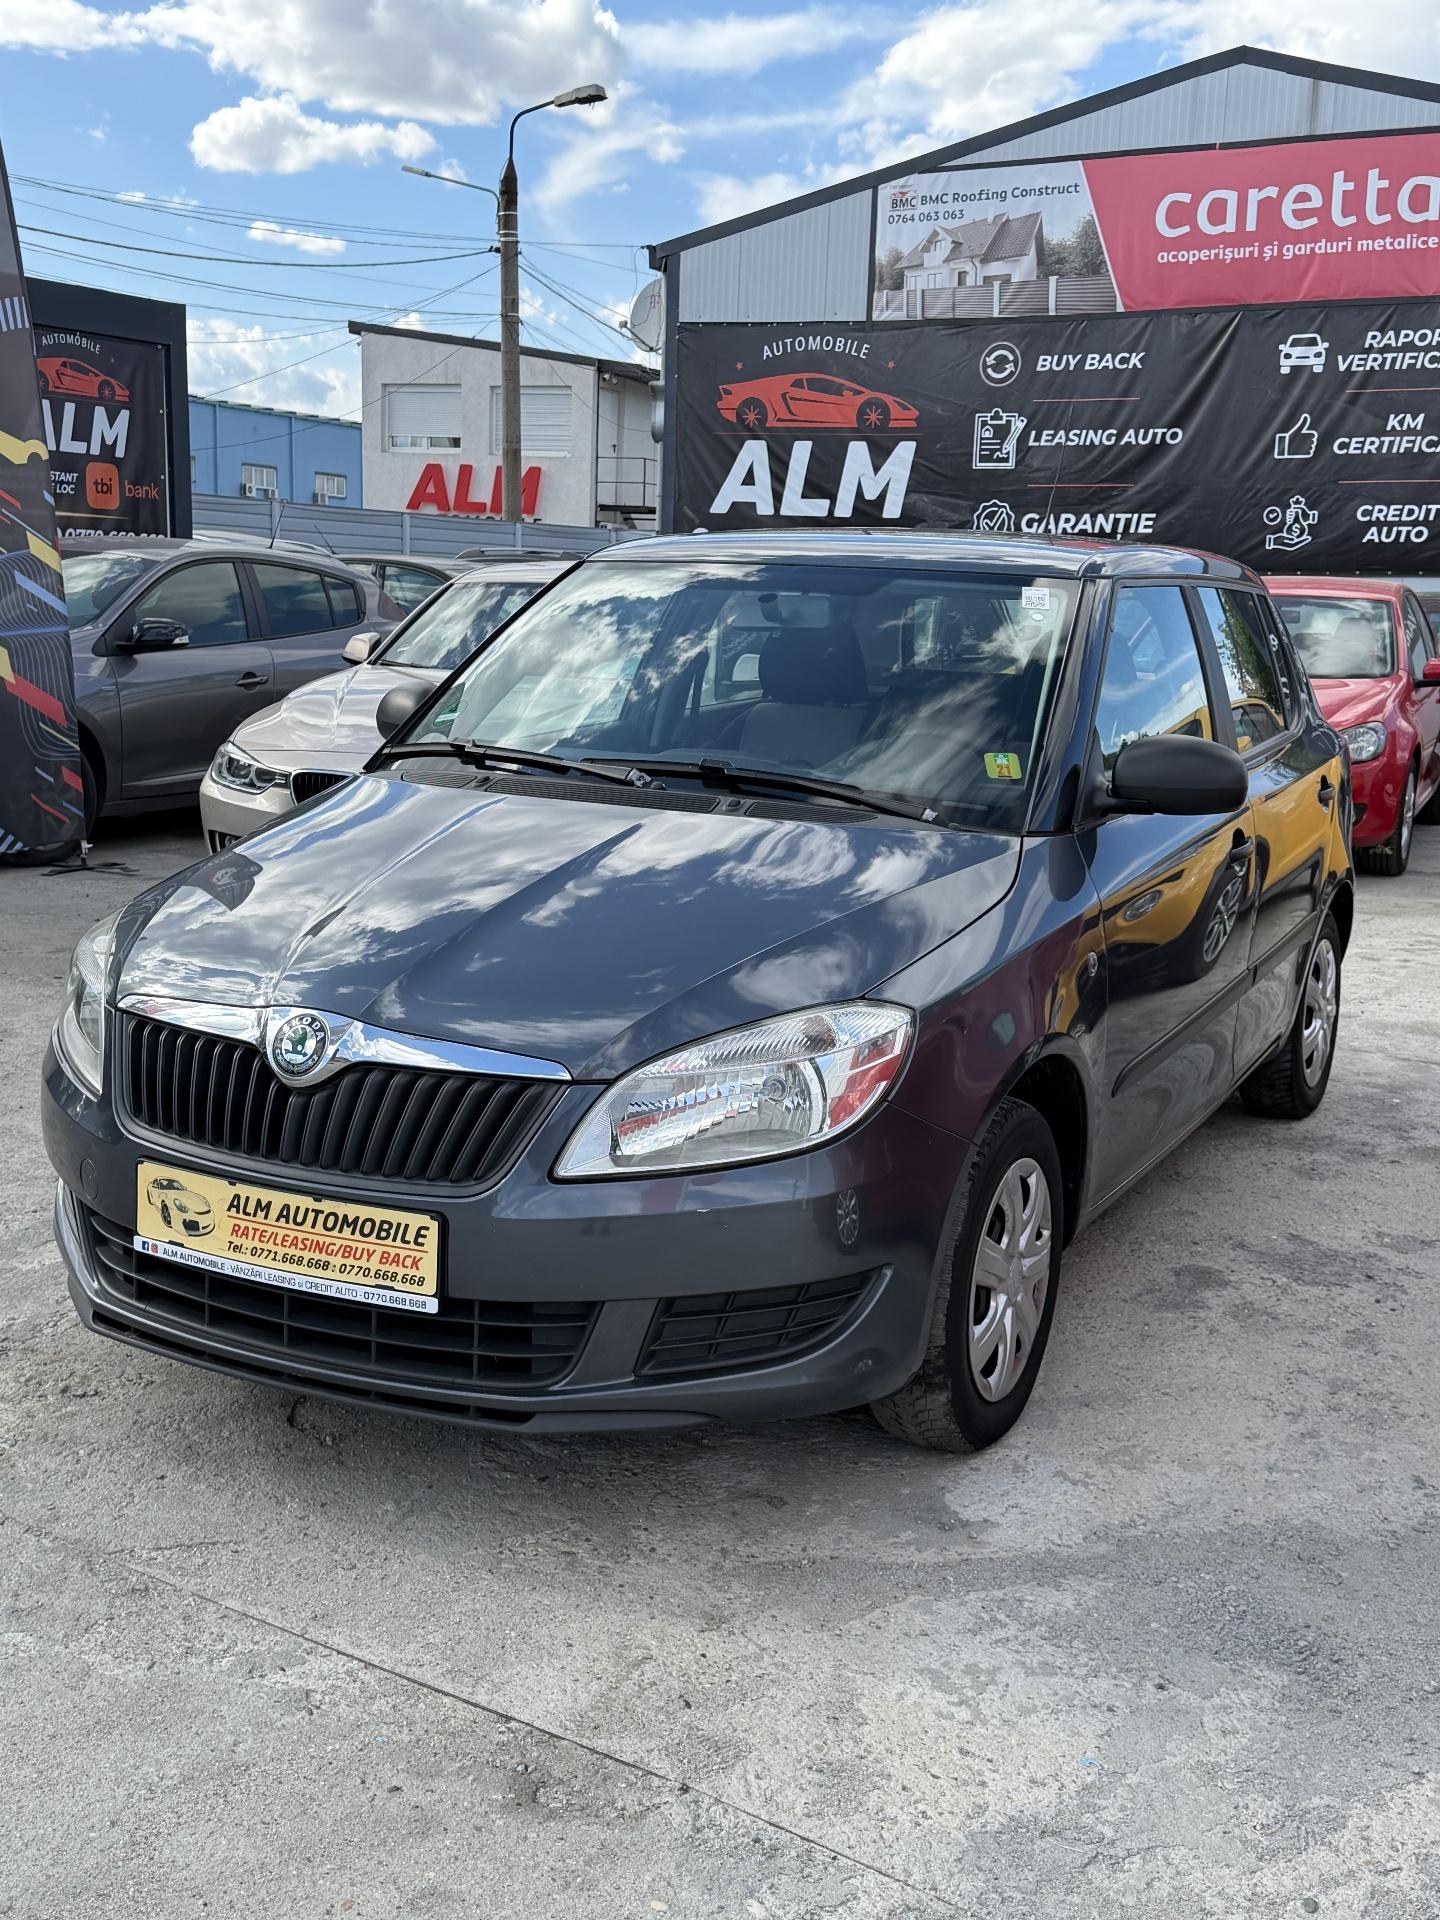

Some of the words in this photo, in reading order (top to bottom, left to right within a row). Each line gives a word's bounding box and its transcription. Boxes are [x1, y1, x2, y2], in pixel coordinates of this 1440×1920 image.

[891, 197, 917, 209] BMC
[920, 193, 949, 206] BMC
[952, 189, 1008, 203] Roofing
[1011, 182, 1080, 198] Construct
[1154, 166, 1440, 239] caretta
[888, 214, 915, 225] 0764
[918, 211, 940, 222] 063
[943, 209, 965, 220] 063
[1156, 242, 1259, 265] acoperișuri
[1262, 240, 1279, 260] și
[1282, 236, 1353, 258] garduri
[1356, 231, 1439, 252] metalice
[42, 333, 101, 355] AUTOMOBILE
[762, 336, 871, 360] AUTOMOBILE
[1035, 354, 1082, 373] BUY
[1084, 351, 1146, 370] BACK
[1337, 351, 1440, 372] VERTIFIC
[1386, 413, 1425, 431] KM
[1028, 428, 1117, 447] LEASING
[1119, 426, 1184, 446] AUTO
[93, 477, 113, 495] tbi
[125, 480, 160, 500] bank
[406, 463, 542, 515] ALM
[709, 439, 917, 519] ALM
[1356, 503, 1440, 522] CREDIT
[1361, 526, 1429, 543] AUTO
[226, 1193, 272, 1220] ALM
[275, 1203, 430, 1247] AUTOMOBILE
[230, 1223, 376, 1263] RATE/LEASING/BUY
[378, 1251, 423, 1271] BACK
[227, 1241, 249, 1256] Tel.:
[250, 1246, 330, 1271] 0771.668.668
[338, 1263, 426, 1287] 0770.668.668
[162, 1247, 178, 1259] ALM
[180, 1252, 225, 1271] AUTOMOBILE
[263, 1270, 296, 1286] LEASING
[305, 1280, 334, 1294] CREDIT
[335, 1286, 358, 1298] AUTO
[363, 1291, 427, 1309] 0770.668.668
